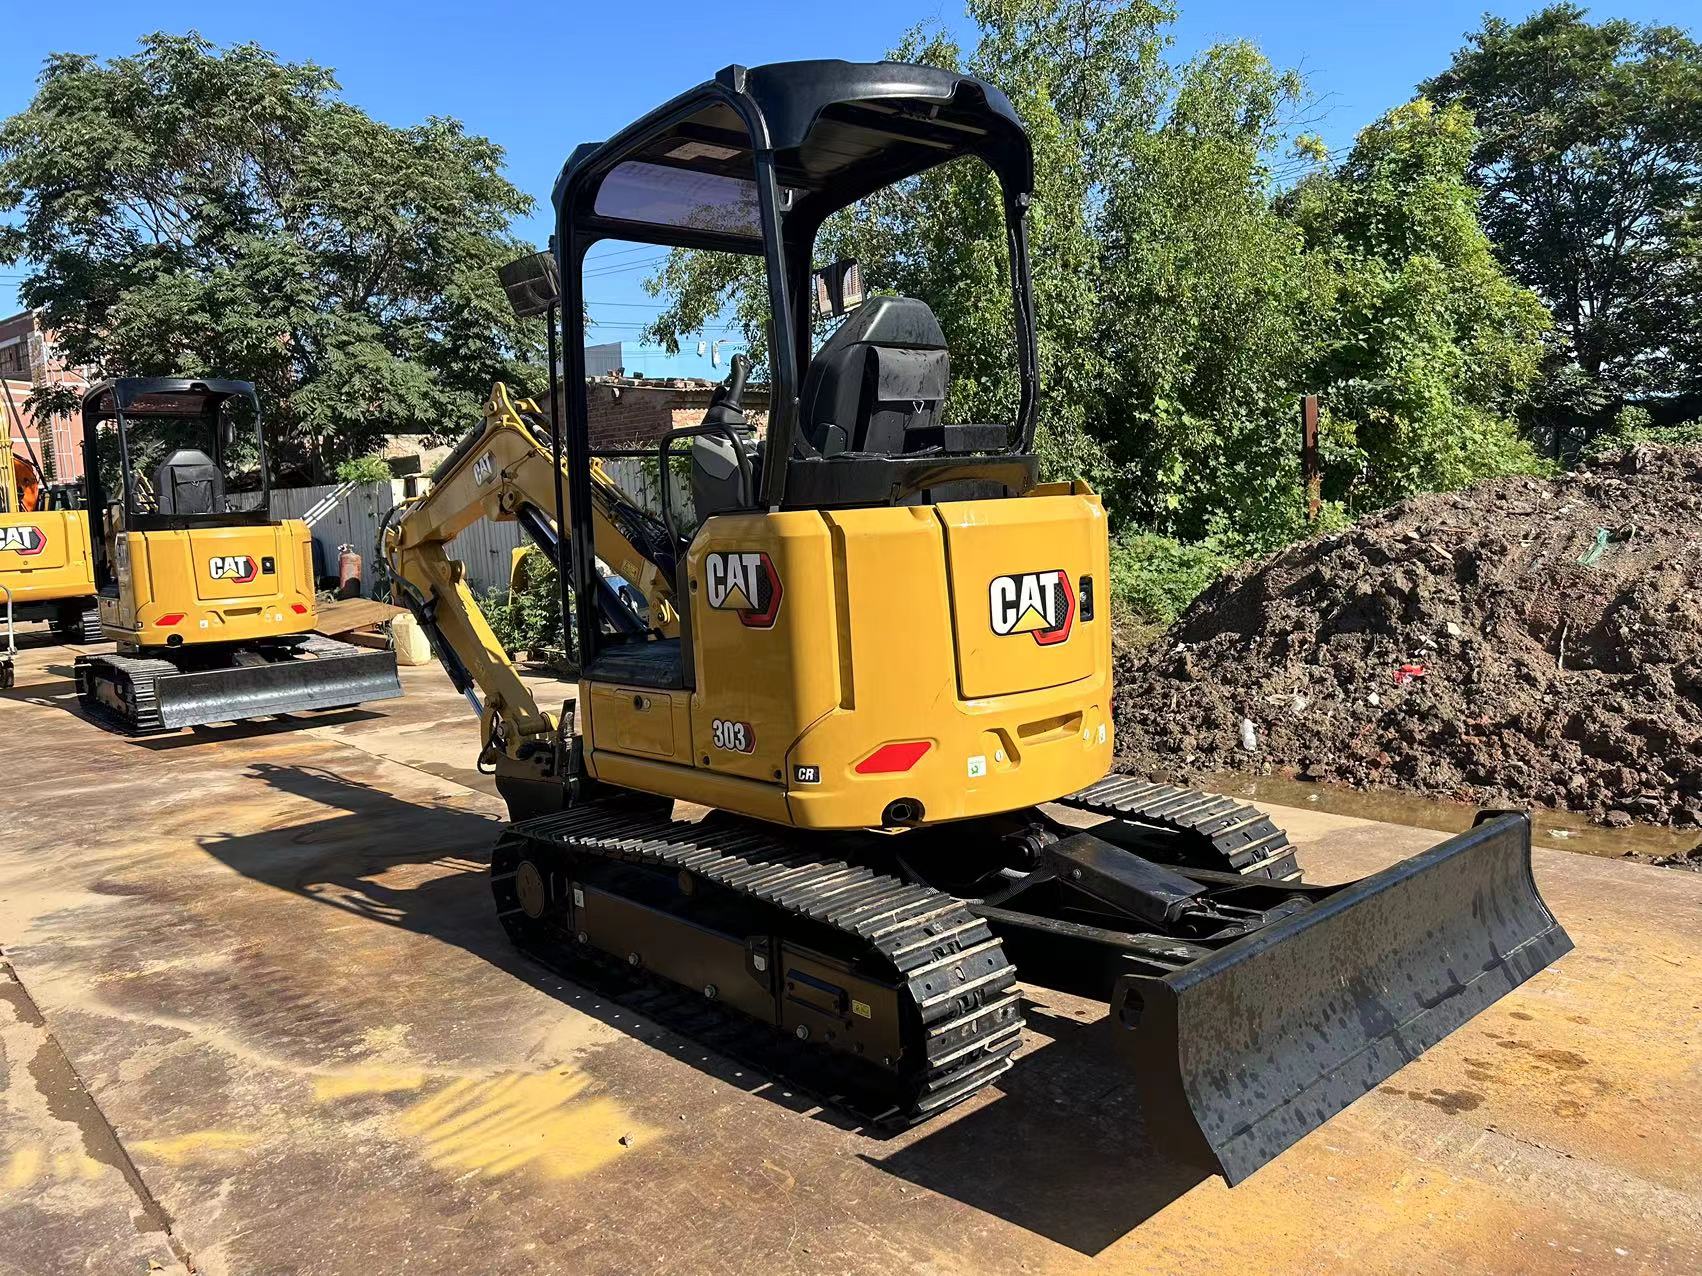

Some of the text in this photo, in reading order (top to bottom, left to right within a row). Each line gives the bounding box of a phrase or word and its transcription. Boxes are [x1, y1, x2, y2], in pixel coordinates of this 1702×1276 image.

[473, 452, 493, 486] CAT
[209, 556, 247, 579] CAT
[706, 553, 761, 608] CAT
[990, 571, 1059, 634] CAT
[712, 719, 746, 750] 303
[798, 768, 815, 781] CR
